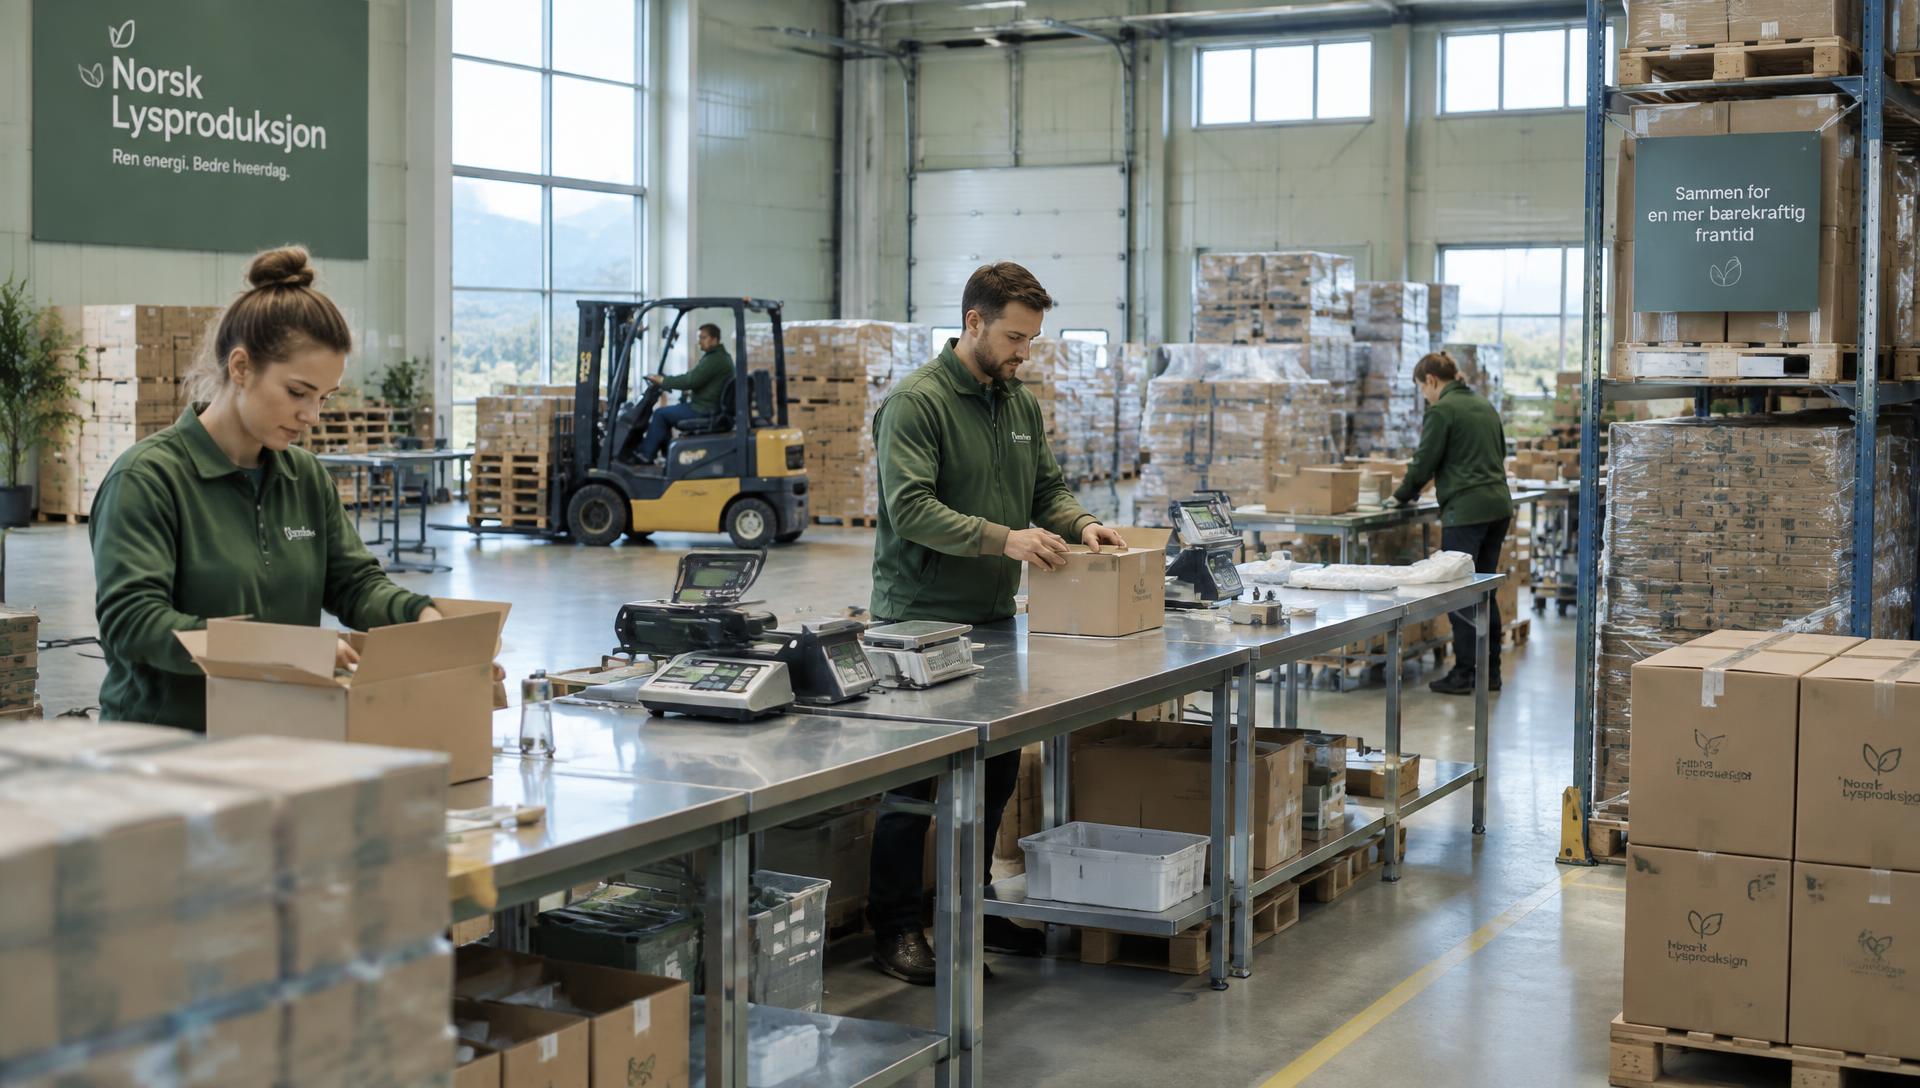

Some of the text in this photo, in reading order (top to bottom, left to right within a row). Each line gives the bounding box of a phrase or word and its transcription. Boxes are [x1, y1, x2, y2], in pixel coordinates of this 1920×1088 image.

[112, 55, 204, 99] Norsk
[112, 94, 327, 153] Lysproduksjon
[112, 149, 140, 166] Ren
[143, 155, 189, 174] energi.
[193, 156, 230, 173] Bedre
[1675, 184, 1771, 201] Sammen for
[1648, 204, 1806, 223] en mer bærekraftig
[1695, 226, 1754, 242] frantid
